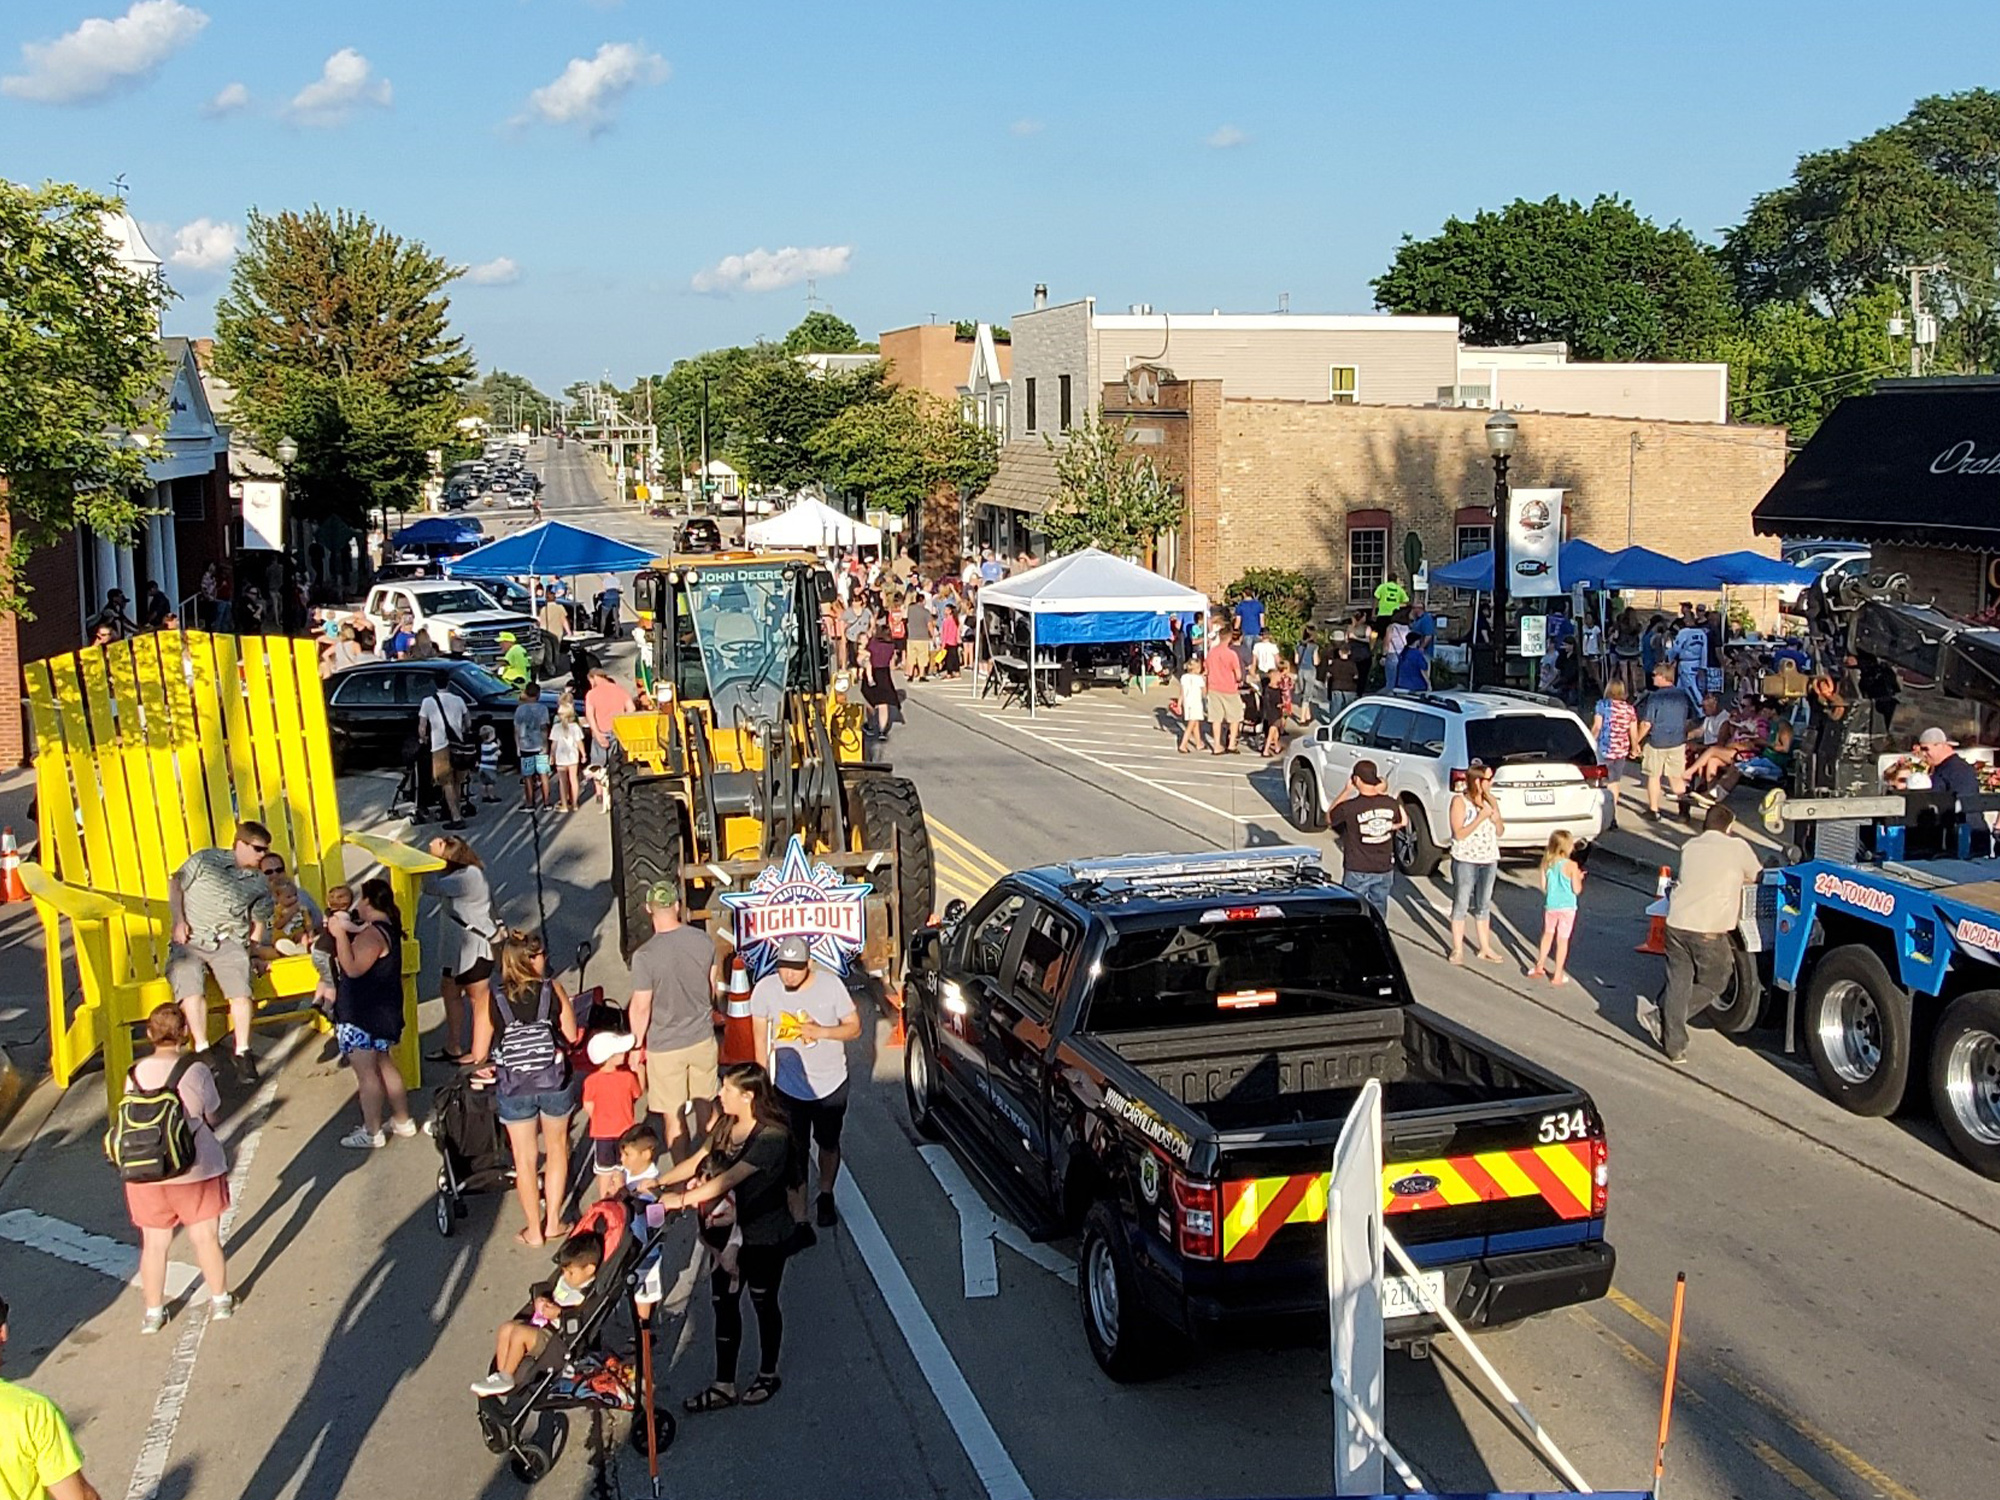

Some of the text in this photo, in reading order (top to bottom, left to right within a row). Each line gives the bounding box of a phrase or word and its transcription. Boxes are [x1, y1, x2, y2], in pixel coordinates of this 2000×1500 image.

[699, 568, 783, 584] JOHN DEERE
[1527, 632, 1541, 642] THIS
[1842, 882, 1893, 913] TOWING
[1538, 1108, 1588, 1143] 534
